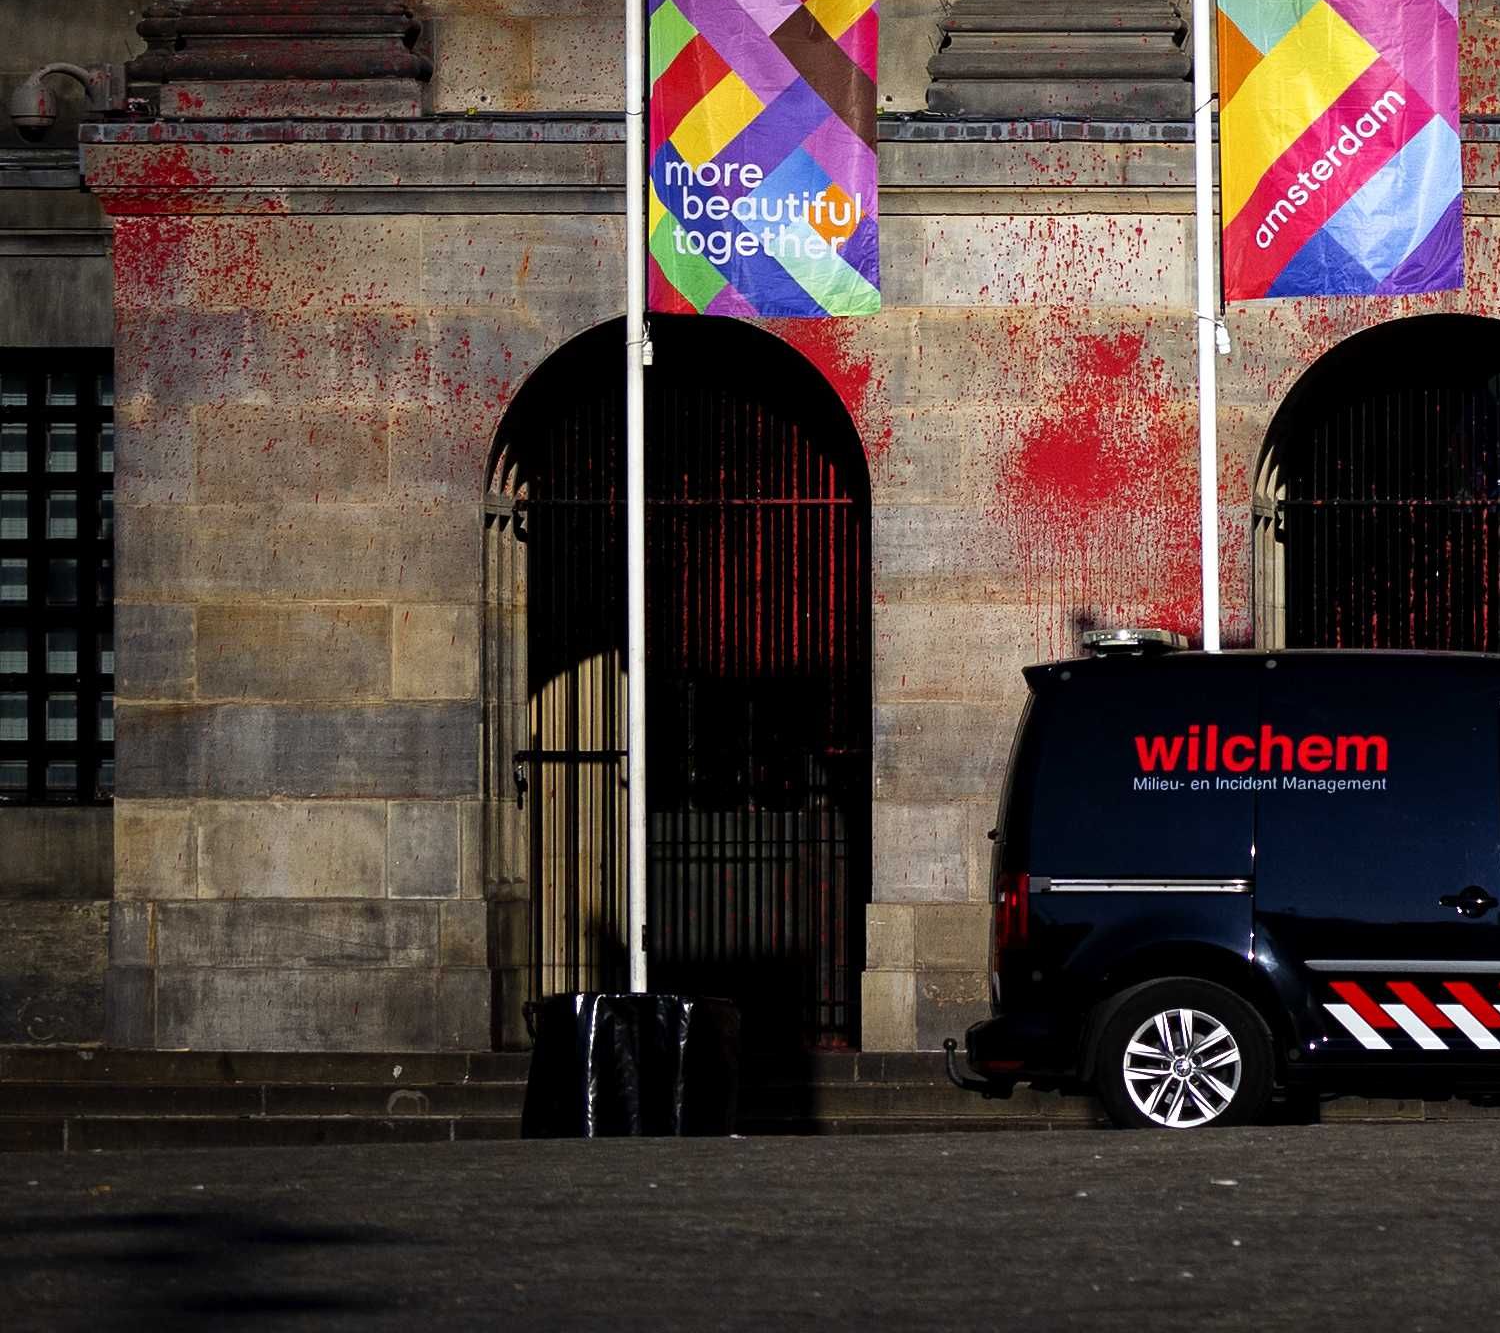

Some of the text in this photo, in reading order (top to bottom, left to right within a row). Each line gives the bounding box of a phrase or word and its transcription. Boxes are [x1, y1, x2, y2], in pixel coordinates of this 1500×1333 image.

[665, 161, 763, 188] more
[1256, 90, 1406, 248] amsterdam
[683, 186, 861, 226] beautiful
[673, 224, 846, 265] together
[1135, 725, 1388, 772] wilchem
[1133, 776, 1387, 793] Milieu- en Incident Management
